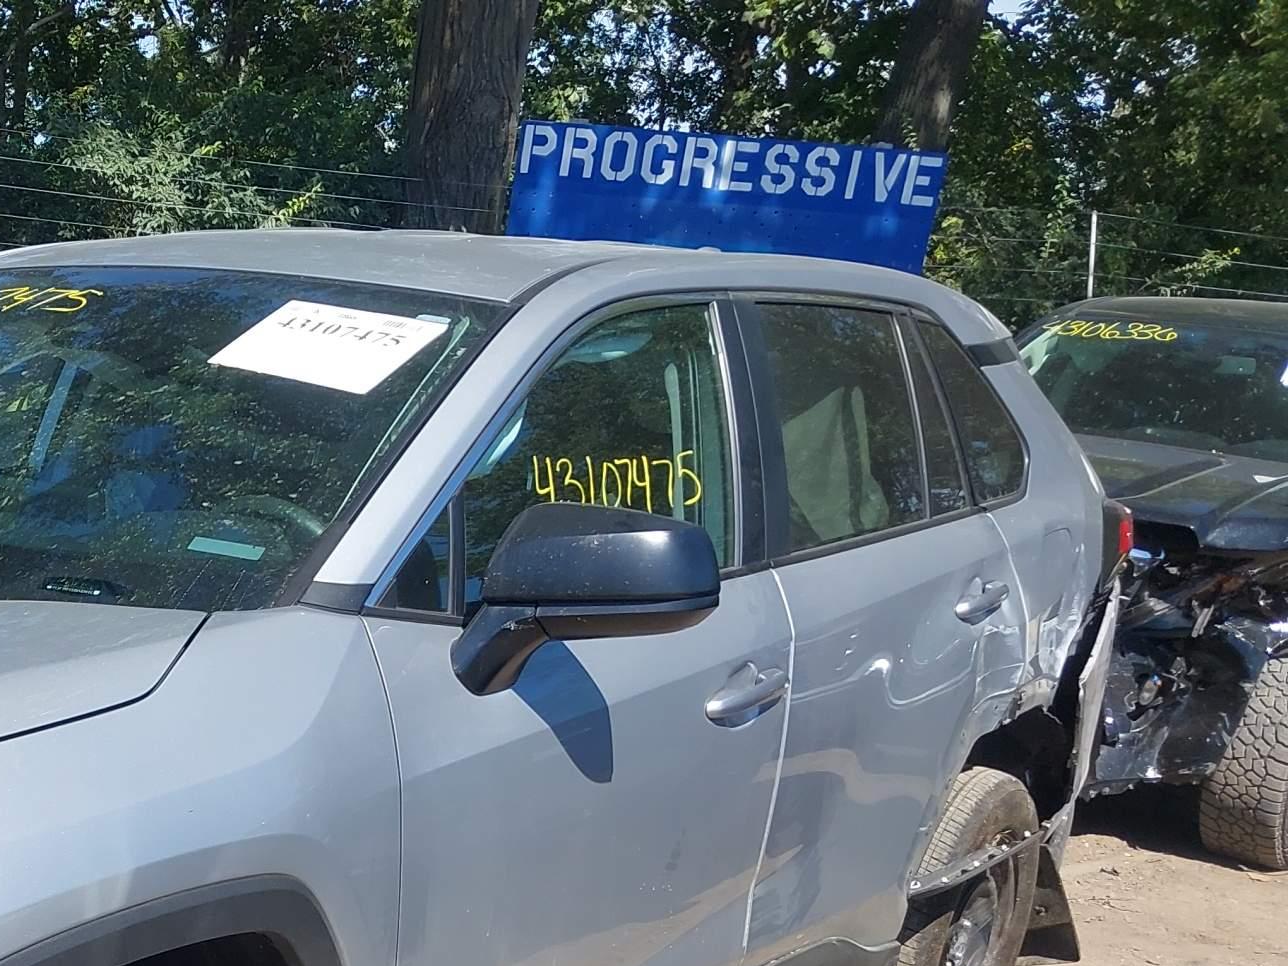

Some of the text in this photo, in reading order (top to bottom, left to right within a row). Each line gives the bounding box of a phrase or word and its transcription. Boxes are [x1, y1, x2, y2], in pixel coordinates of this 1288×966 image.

[519, 124, 944, 208] PROGRESSIVE
[277, 316, 408, 347] 43107475
[532, 450, 702, 514] 43107475
